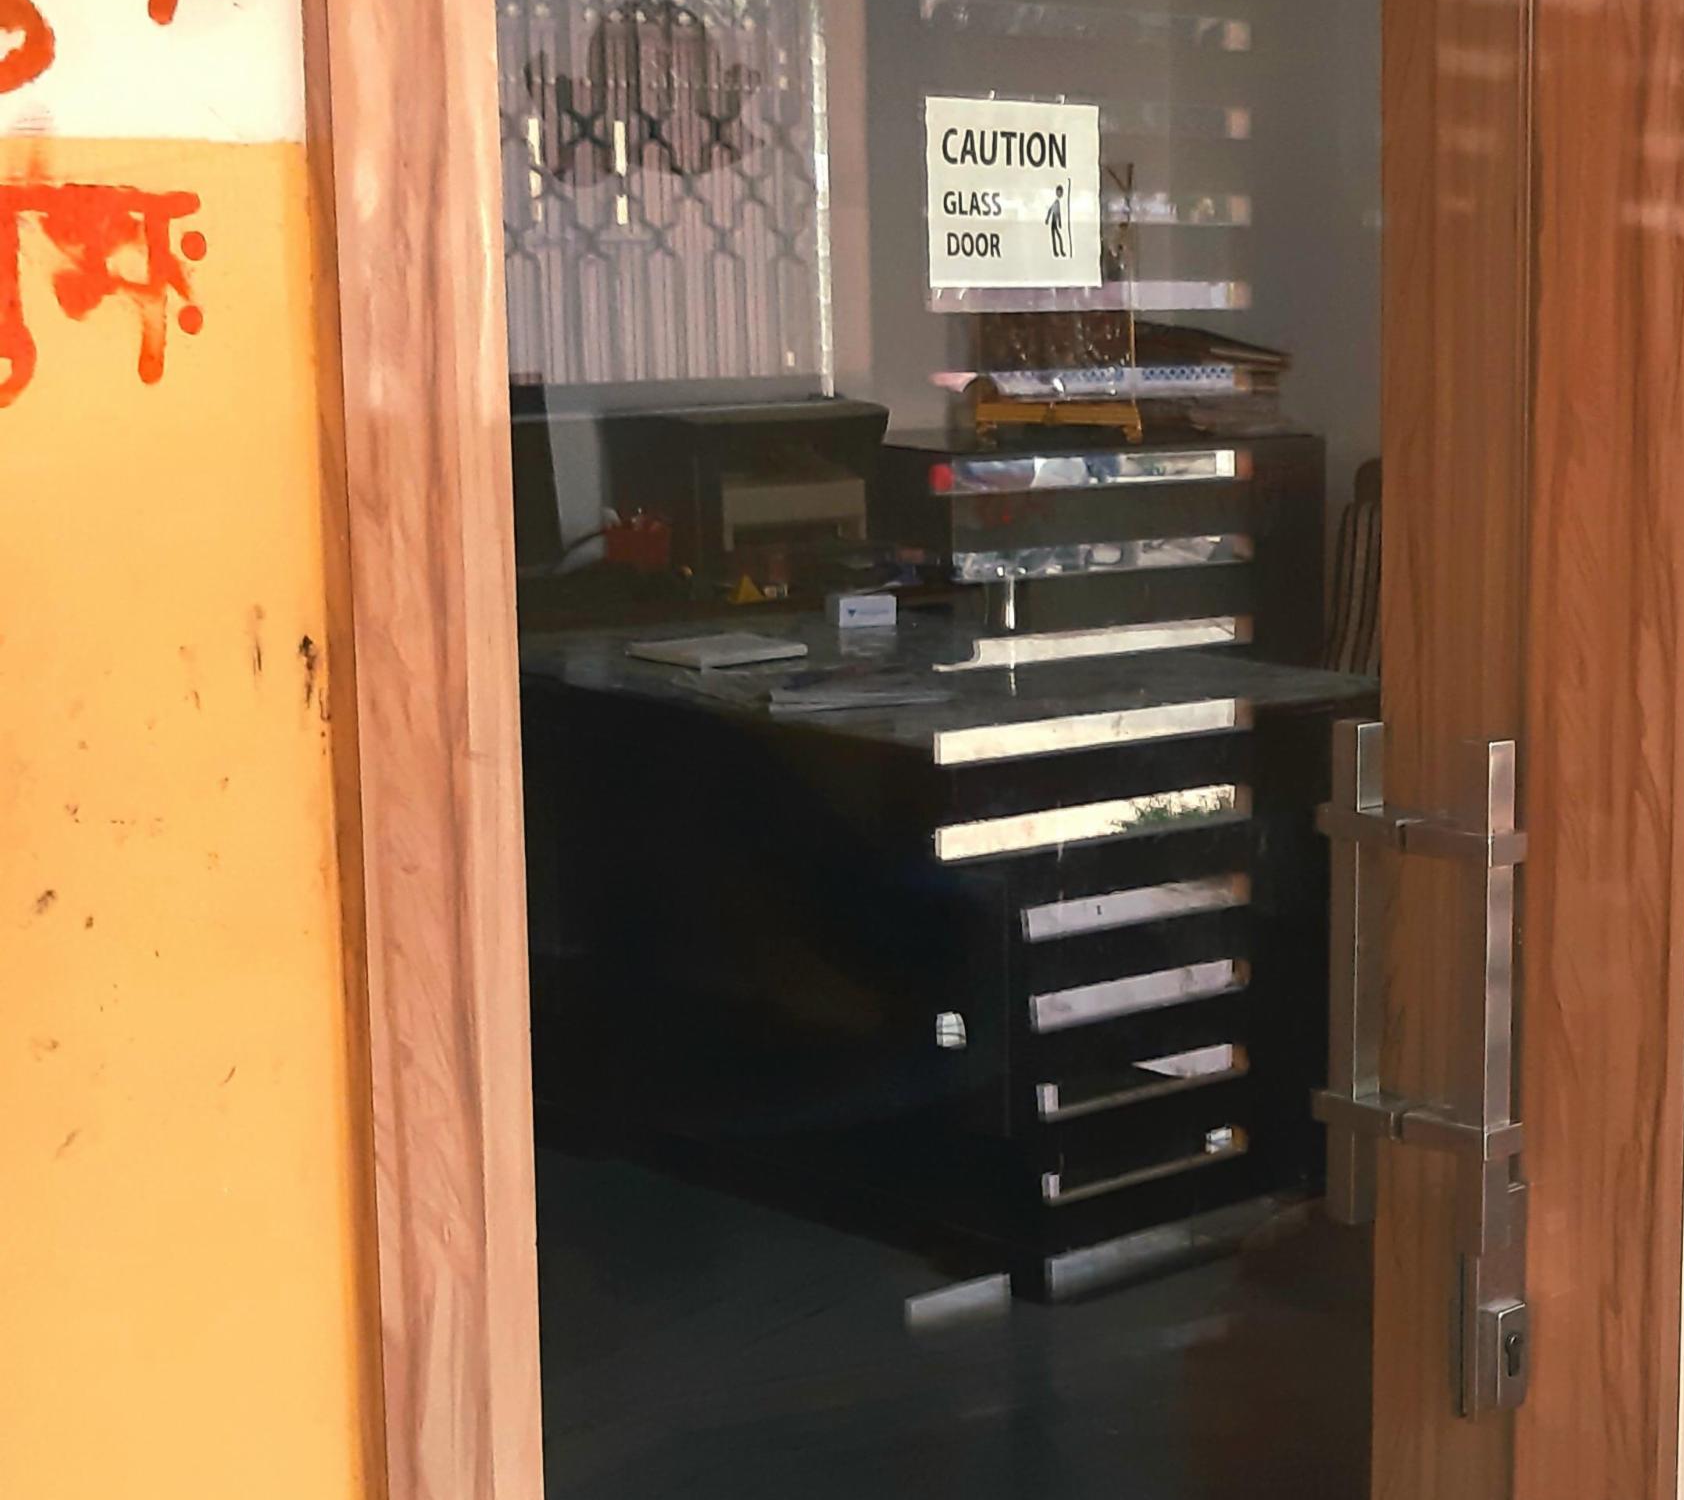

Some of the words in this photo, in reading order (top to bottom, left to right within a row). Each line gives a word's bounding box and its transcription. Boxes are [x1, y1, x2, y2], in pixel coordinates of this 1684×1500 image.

[941, 127, 1067, 169] CAUTION
[943, 190, 1002, 217] GLASS
[946, 232, 1001, 258] DOOR
